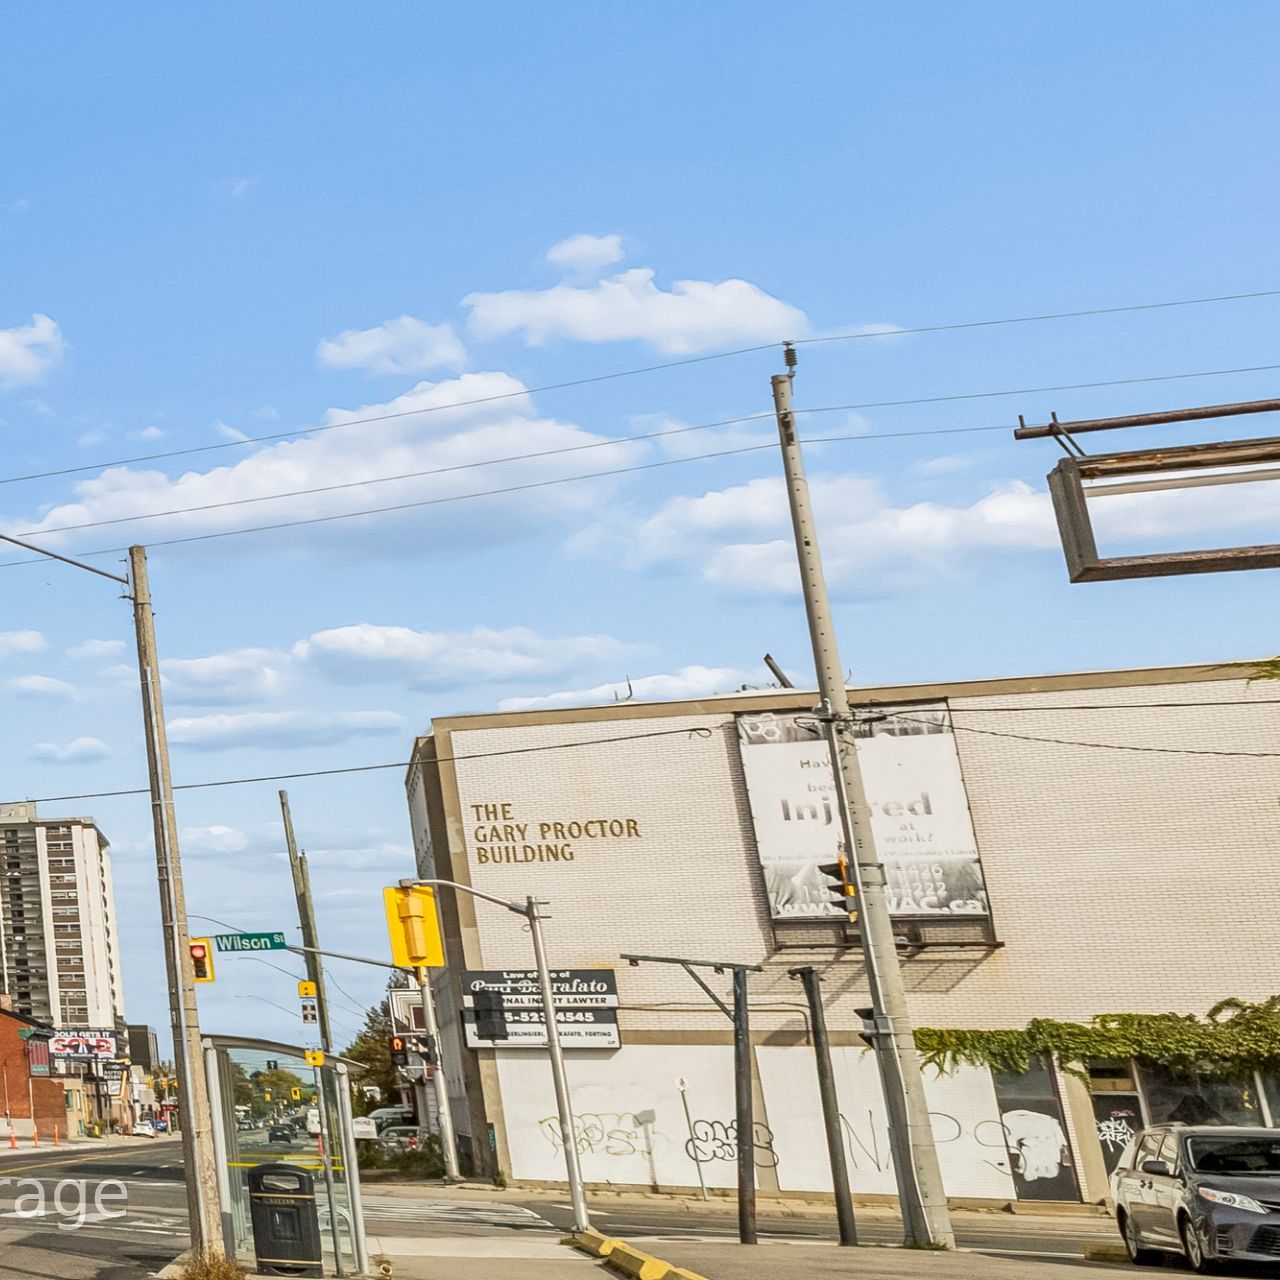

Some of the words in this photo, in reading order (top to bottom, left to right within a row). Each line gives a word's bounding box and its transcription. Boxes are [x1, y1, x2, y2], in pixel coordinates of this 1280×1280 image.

[800, 759, 833, 769] Hav
[471, 803, 514, 821] THE
[781, 791, 933, 826] Injed
[474, 824, 528, 843] GARY
[540, 819, 641, 840] PROCTOR
[477, 844, 574, 864] BUILDING
[217, 936, 271, 951] Wilson
[273, 933, 285, 943] St
[560, 971, 570, 979] of
